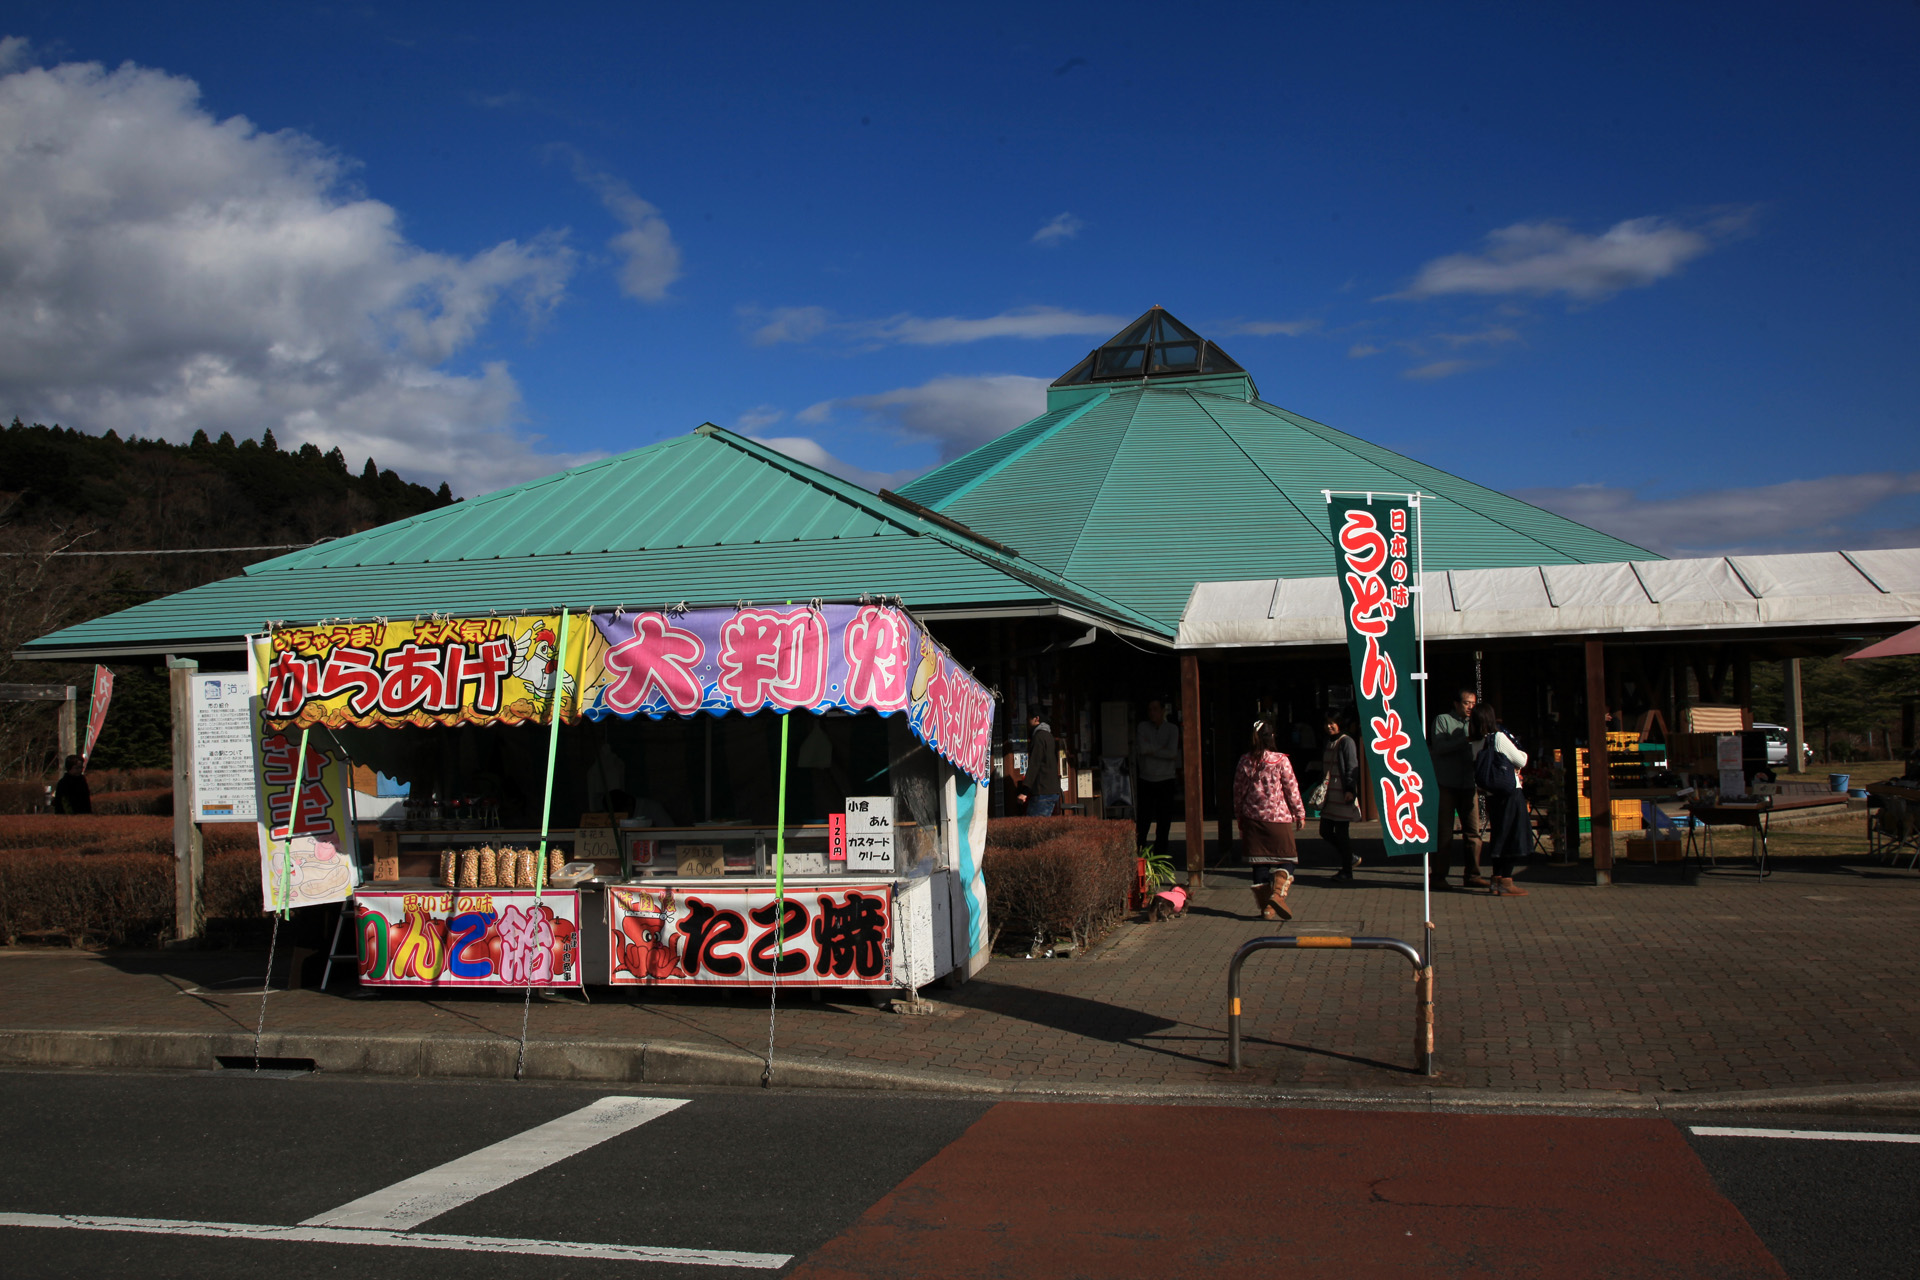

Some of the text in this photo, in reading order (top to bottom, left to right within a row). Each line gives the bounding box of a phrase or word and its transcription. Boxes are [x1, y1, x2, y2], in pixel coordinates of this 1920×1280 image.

[1390, 508, 1409, 608] 日本の味
[267, 640, 512, 717] からあげ
[848, 800, 869, 812] 小倉
[869, 816, 889, 826] あん
[833, 817, 842, 856] 120円
[848, 837, 890, 847] カスタード
[583, 842, 617, 857] 500円
[858, 851, 890, 861] クリーム
[686, 862, 721, 875] 400円
[402, 893, 494, 914] 思い出の味
[676, 890, 889, 979] たこ焼
